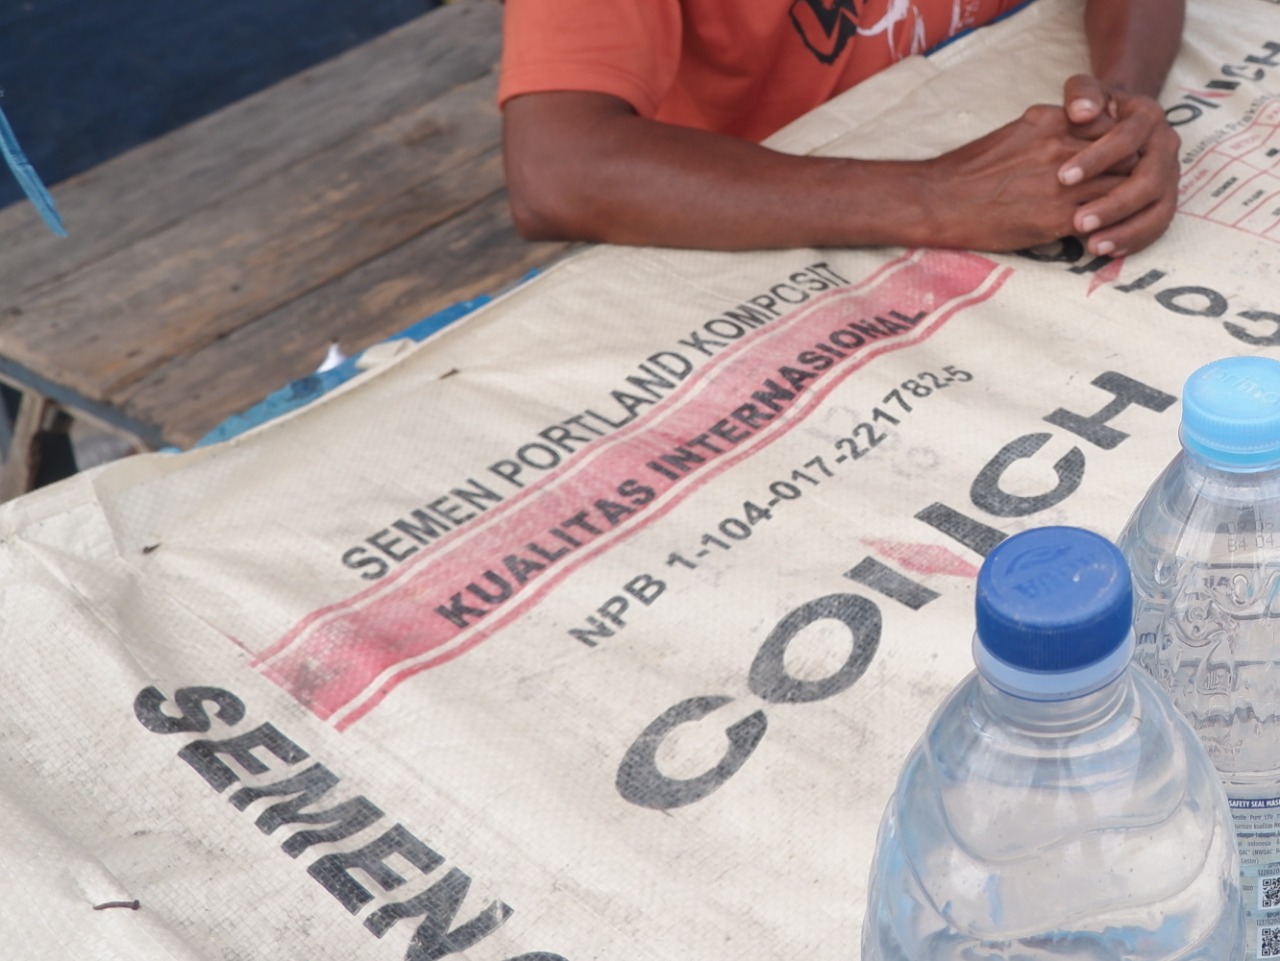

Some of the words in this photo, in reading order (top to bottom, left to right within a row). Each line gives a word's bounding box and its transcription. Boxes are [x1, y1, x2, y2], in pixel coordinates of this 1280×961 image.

[341, 478, 500, 582] SEMEN
[488, 347, 694, 494] PORTLAND
[679, 260, 853, 358] KOMPOSIT
[433, 476, 656, 630] KUALITAS
[647, 305, 929, 480] INTERNASIONAL
[567, 571, 669, 648] NPB
[666, 363, 975, 575] 1-104-017-221782-5
[1228, 800, 1249, 808] SAFETY
[1250, 799, 1265, 808] SEAL
